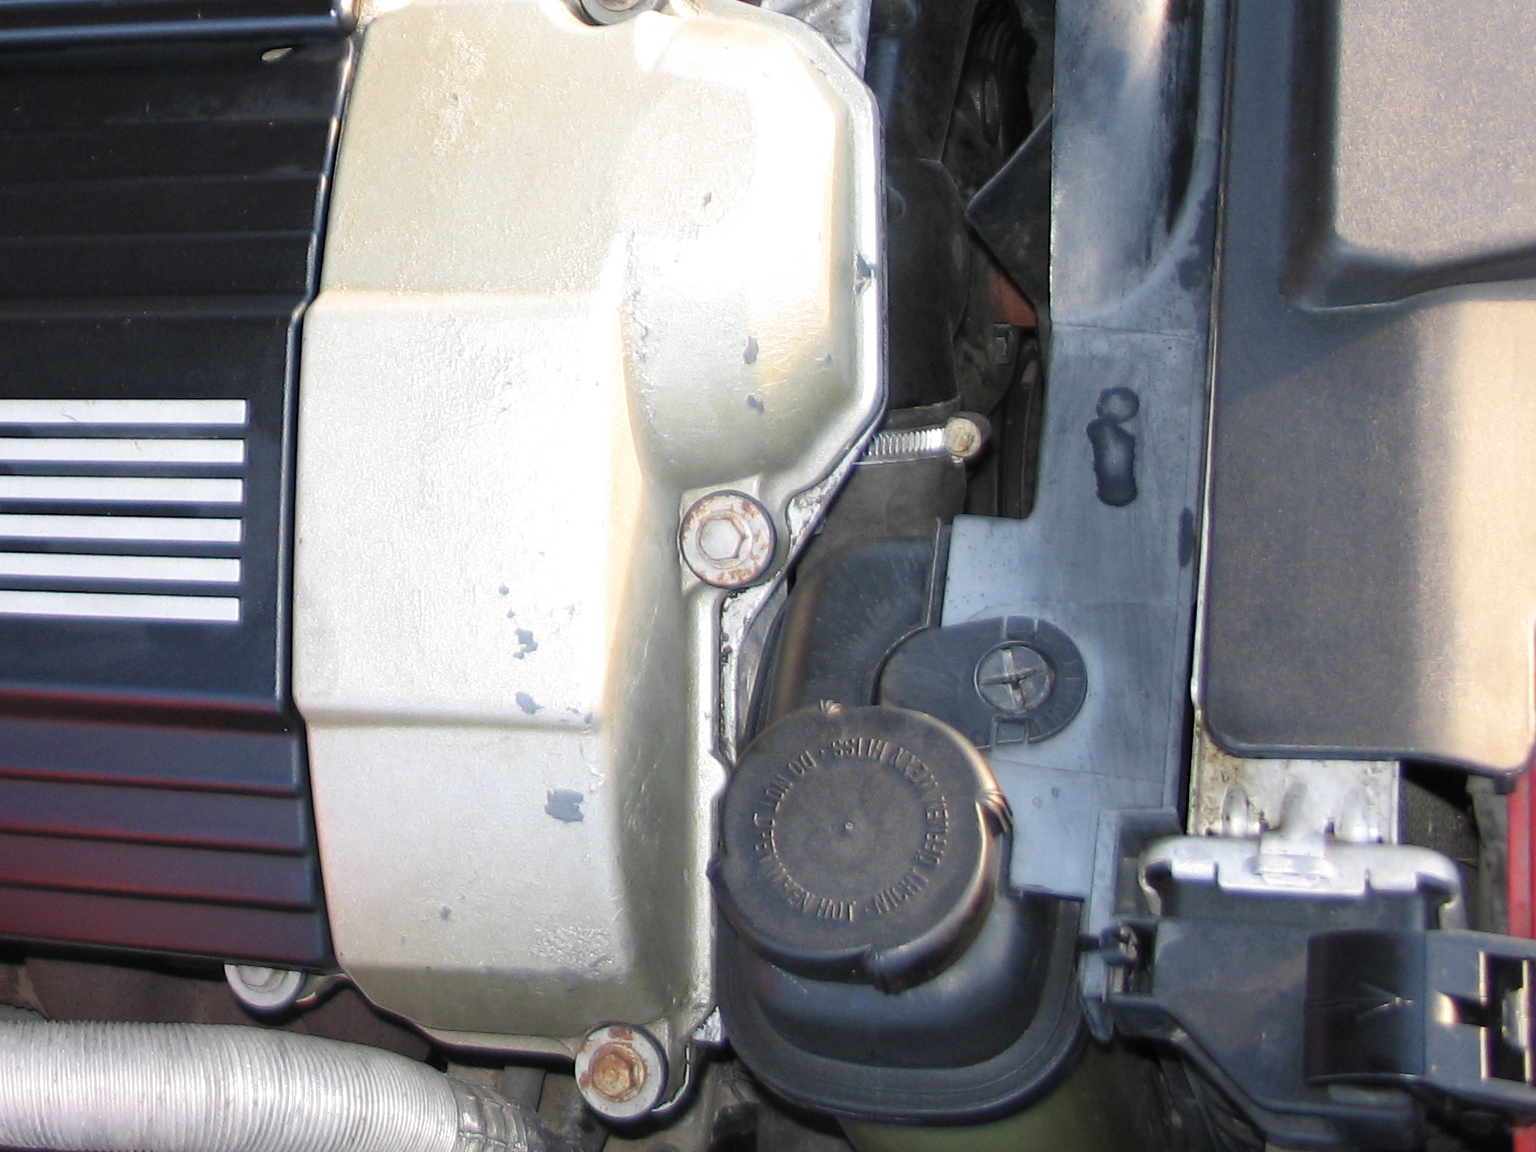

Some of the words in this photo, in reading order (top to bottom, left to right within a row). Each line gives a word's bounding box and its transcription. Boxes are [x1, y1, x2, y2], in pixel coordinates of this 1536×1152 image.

[787, 749, 817, 776] DO
[762, 773, 794, 813] NOT
[872, 867, 929, 915] NICHT
